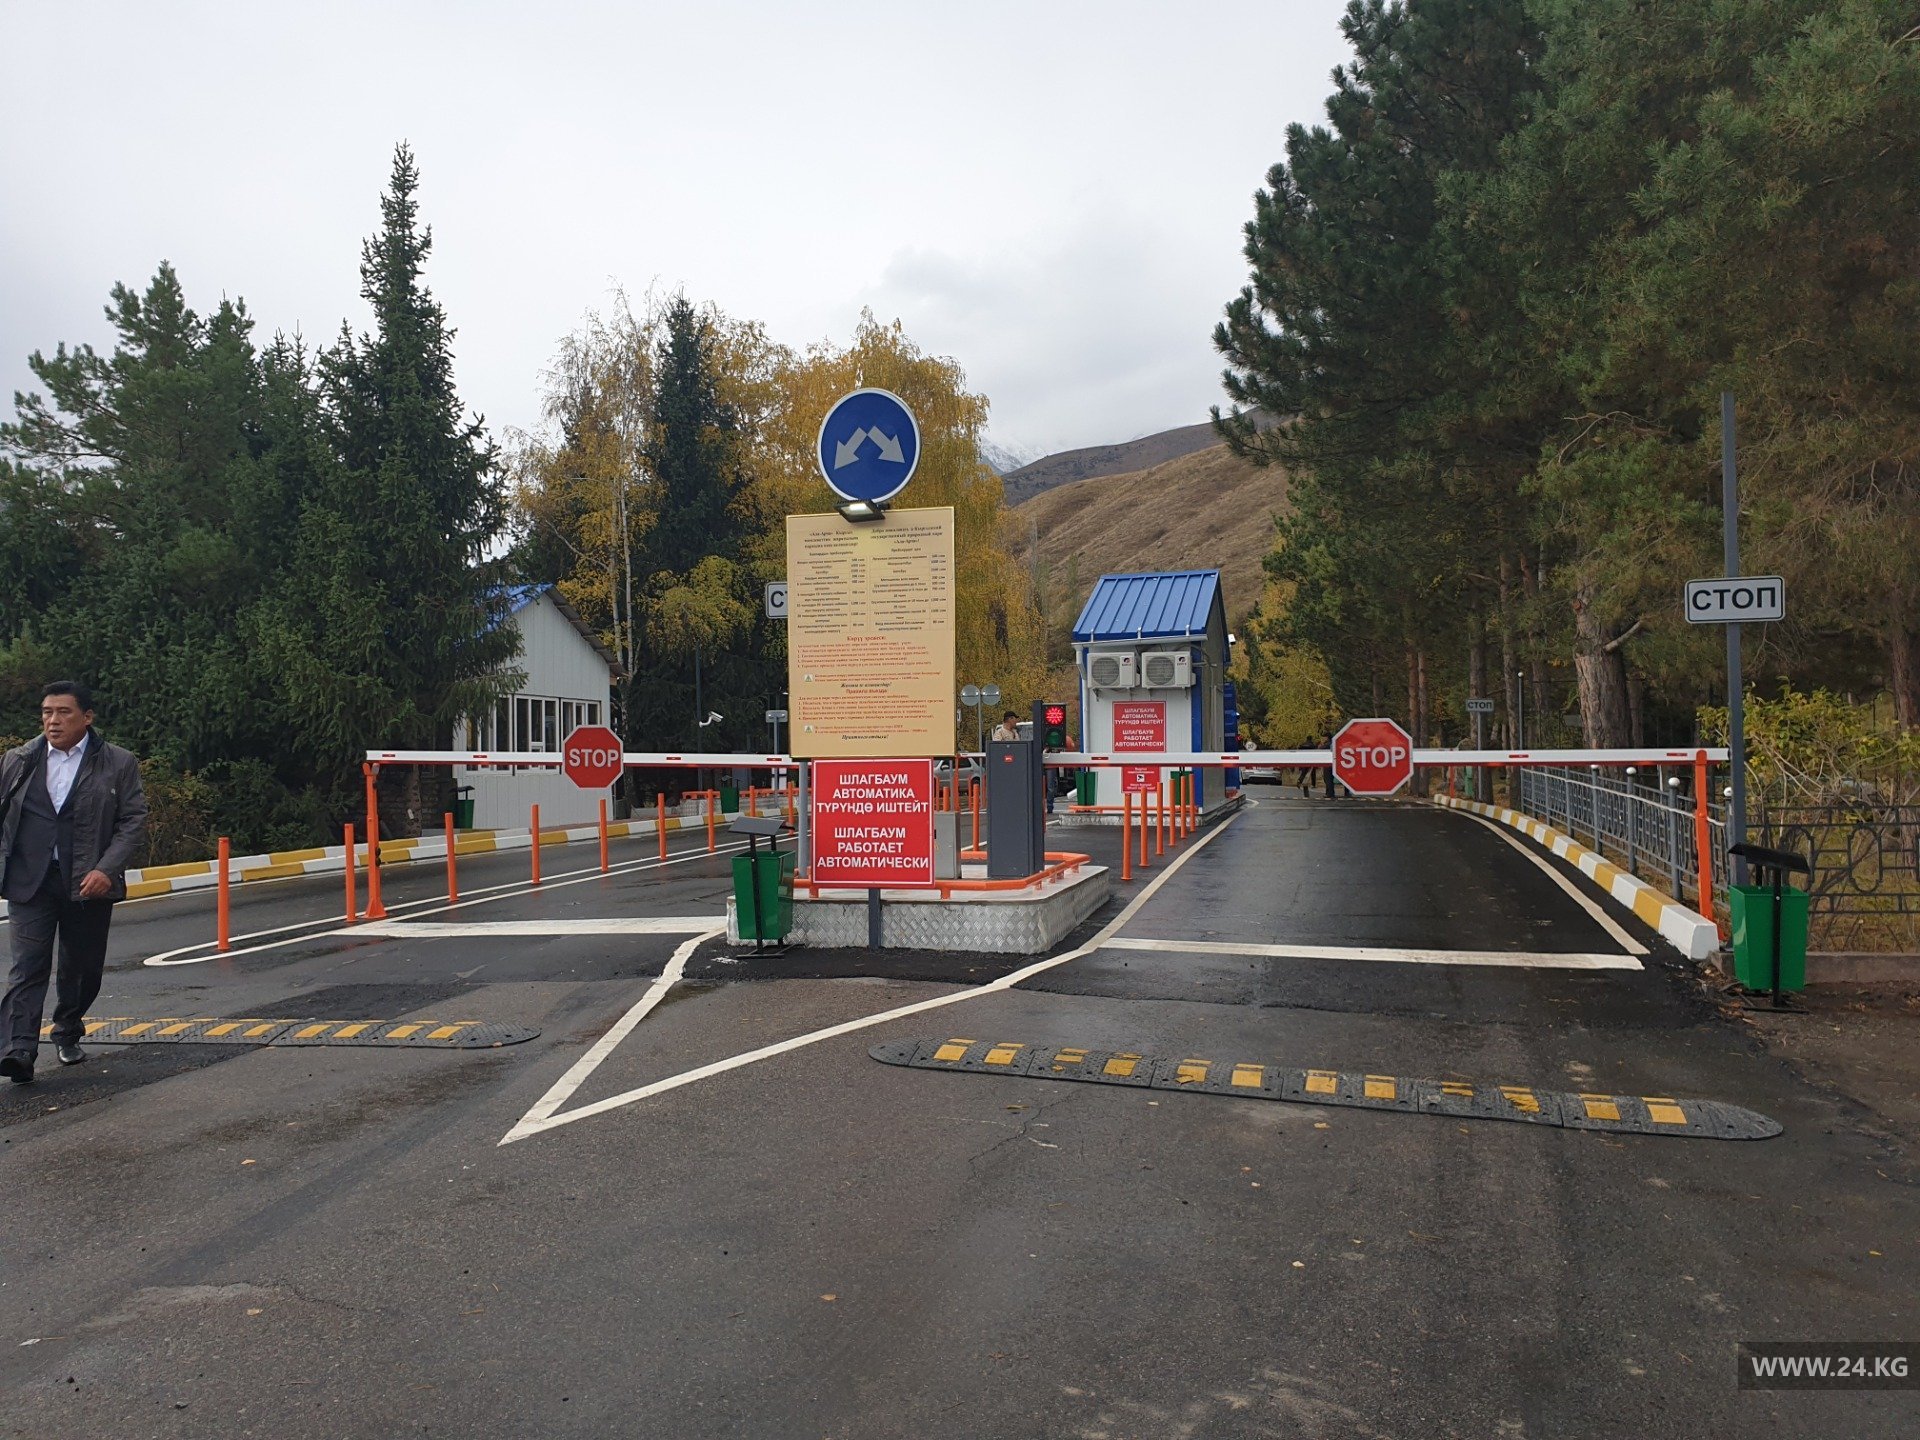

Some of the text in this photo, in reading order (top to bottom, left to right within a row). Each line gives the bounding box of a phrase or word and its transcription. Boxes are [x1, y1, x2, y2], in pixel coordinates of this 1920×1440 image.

[1692, 587, 1776, 610] СТОП
[569, 748, 619, 767] STOP
[1340, 746, 1406, 769] STOP
[839, 774, 908, 785] ШЛАГБАУМ
[832, 788, 915, 799] АВТОМАТИКА
[877, 800, 928, 813] ИШТЕЙТ
[834, 828, 906, 838] ШЛАГБАУМ
[838, 842, 904, 853] РАБОТАЕТ
[817, 857, 929, 868] АВТОМАТИЧЕСКИ
